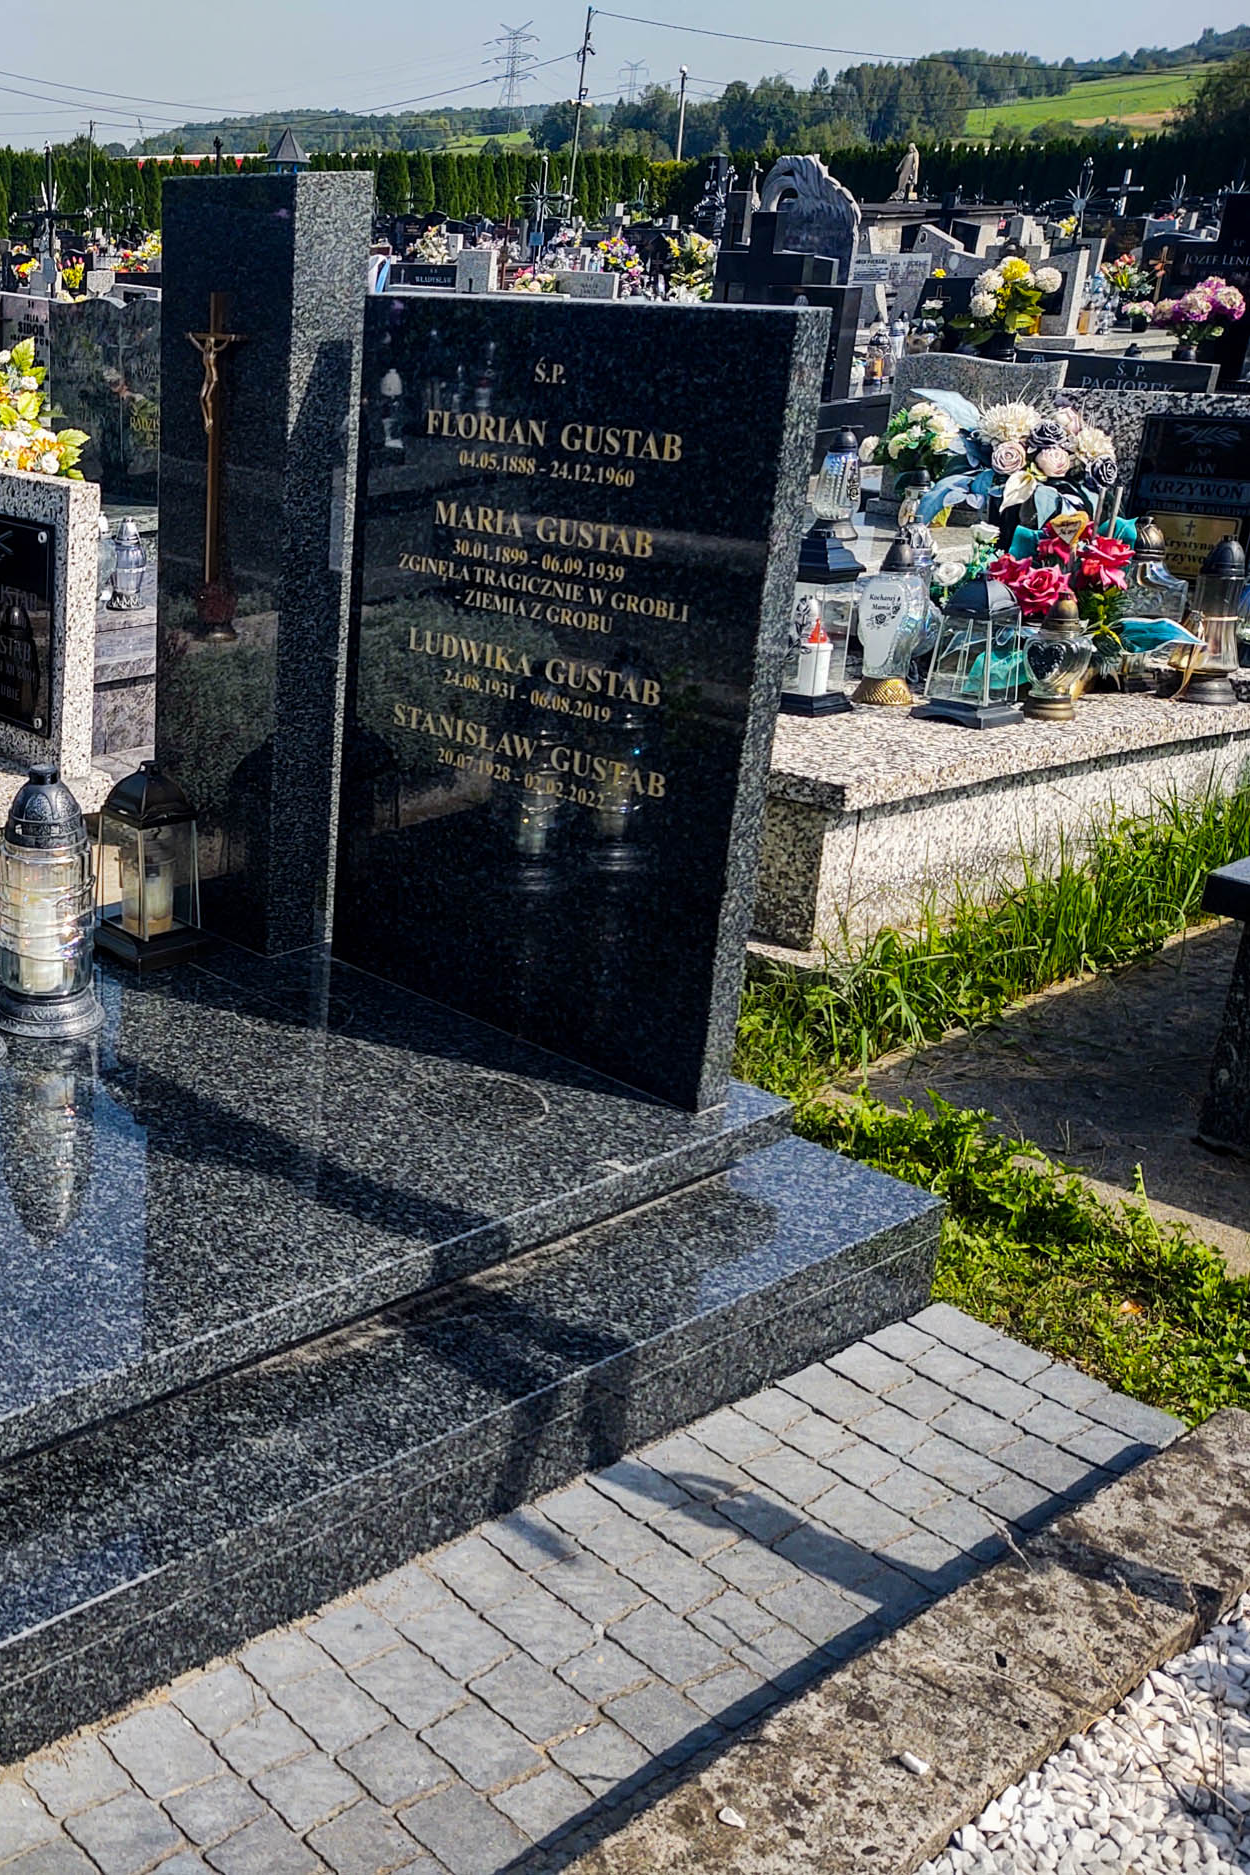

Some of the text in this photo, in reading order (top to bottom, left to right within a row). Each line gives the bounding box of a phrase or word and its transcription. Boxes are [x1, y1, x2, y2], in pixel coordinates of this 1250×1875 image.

[534, 357, 567, 384] Ś.P.
[426, 409, 683, 462] FLORIAN GUSTAB
[458, 449, 537, 476] 04.05.1888
[549, 460, 636, 488] 24.12.1960
[434, 500, 654, 559] MARIA GUSTAB
[398, 552, 690, 623] ZGINĘŁA TRAGICZNIE W GROBLI
[452, 538, 529, 567] 30.01.1899
[541, 554, 626, 584] 06.09.1939
[463, 588, 527, 617] ZIEMIA
[529, 602, 543, 621] Z
[545, 605, 613, 634] GROBU
[409, 626, 661, 706] LUDWIKA GUSTAB
[443, 668, 516, 700] 24.08.1931
[530, 689, 611, 723] 06.08.2019
[393, 703, 667, 798] STANISŁAW GUSTAB
[437, 748, 510, 782] 20.07.1928
[524, 774, 605, 809] 02.02.2022
